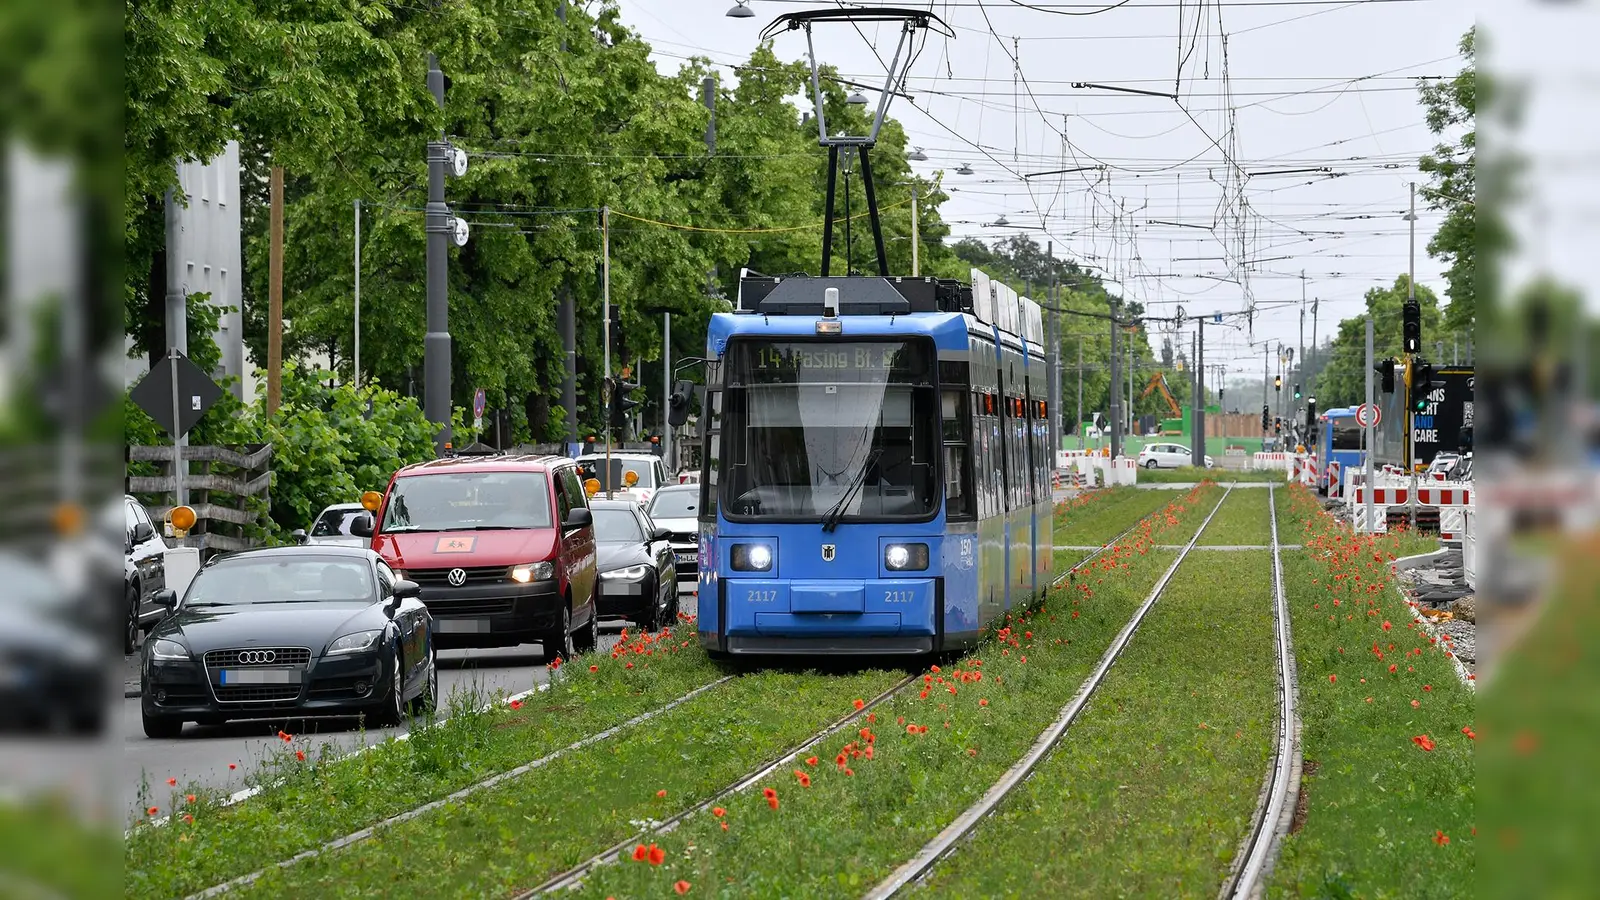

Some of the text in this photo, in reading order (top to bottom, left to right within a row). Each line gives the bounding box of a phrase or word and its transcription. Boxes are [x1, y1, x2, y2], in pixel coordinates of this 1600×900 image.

[758, 348, 781, 369] 14
[793, 348, 848, 368] Pasing
[1427, 388, 1445, 402] ANS
[1415, 402, 1438, 416] RT
[1414, 415, 1434, 429] AND
[743, 505, 754, 516] 31
[747, 590, 777, 602] 2117
[884, 591, 915, 603] 2117
